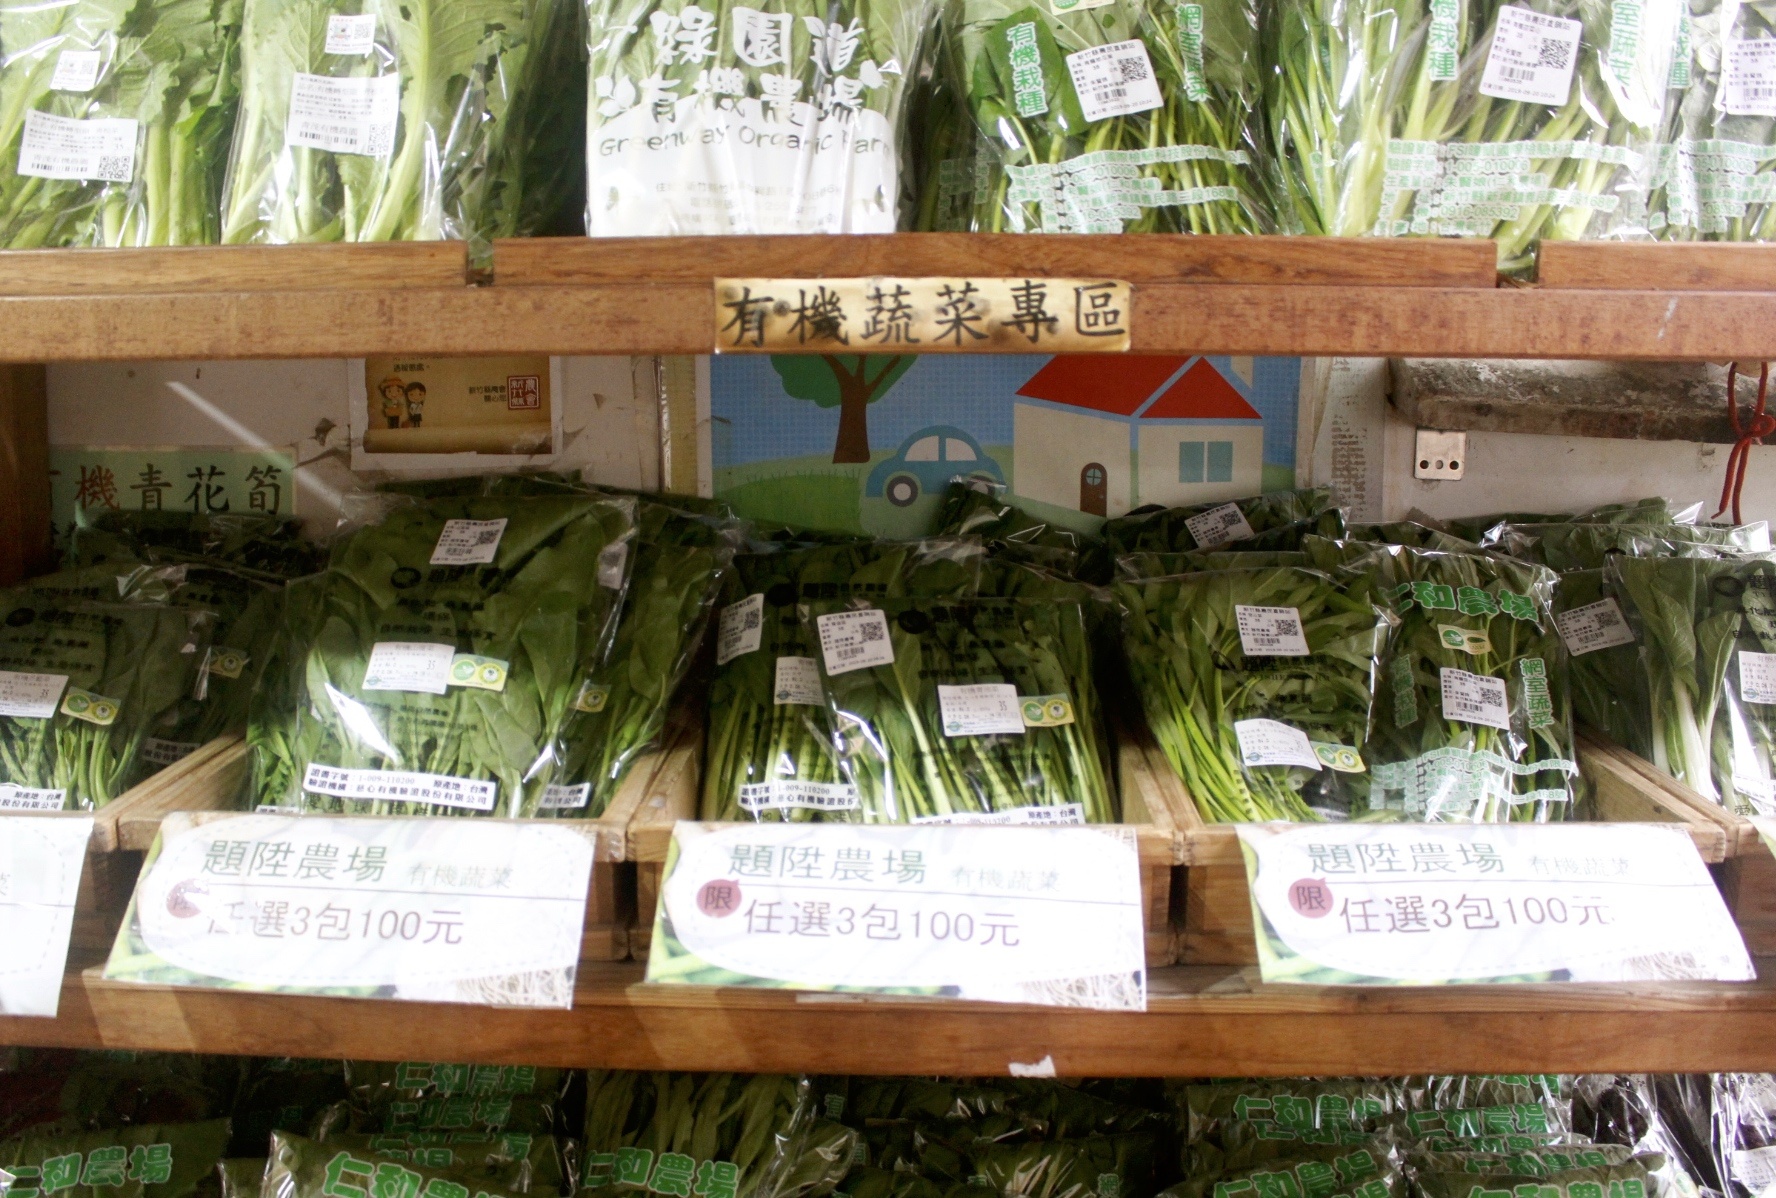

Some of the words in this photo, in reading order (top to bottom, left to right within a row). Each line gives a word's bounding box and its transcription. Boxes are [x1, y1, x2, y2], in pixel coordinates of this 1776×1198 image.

[1429, 0, 1458, 80] 機栽種
[1737, 41, 1776, 51] 新竹縣農
[1008, 22, 1048, 117] 有機栽種
[723, 279, 1127, 347] 有機蔬菜專區
[49, 462, 281, 516] 機青花筍
[1521, 659, 1554, 728] 網室蔬菜
[0, 799, 59, 810] 股份有限公司
[433, 780, 488, 796] 原產地：台灣
[203, 839, 389, 883] 題陞農場
[408, 863, 514, 889] 有機蔬菜
[728, 844, 926, 884] 題陞農場
[950, 865, 1061, 892] 有機蔬菜
[1307, 841, 1505, 875] 題陞農場
[703, 885, 733, 911] 限
[1295, 885, 1326, 910] 限
[1340, 894, 1610, 935] 任選3包100元
[745, 898, 1021, 947] 任選3包100元
[1406, 1103, 1549, 1138] 仁和農場
[323, 1151, 505, 1198] 仁和
[584, 1147, 739, 1198] 仁和農場
